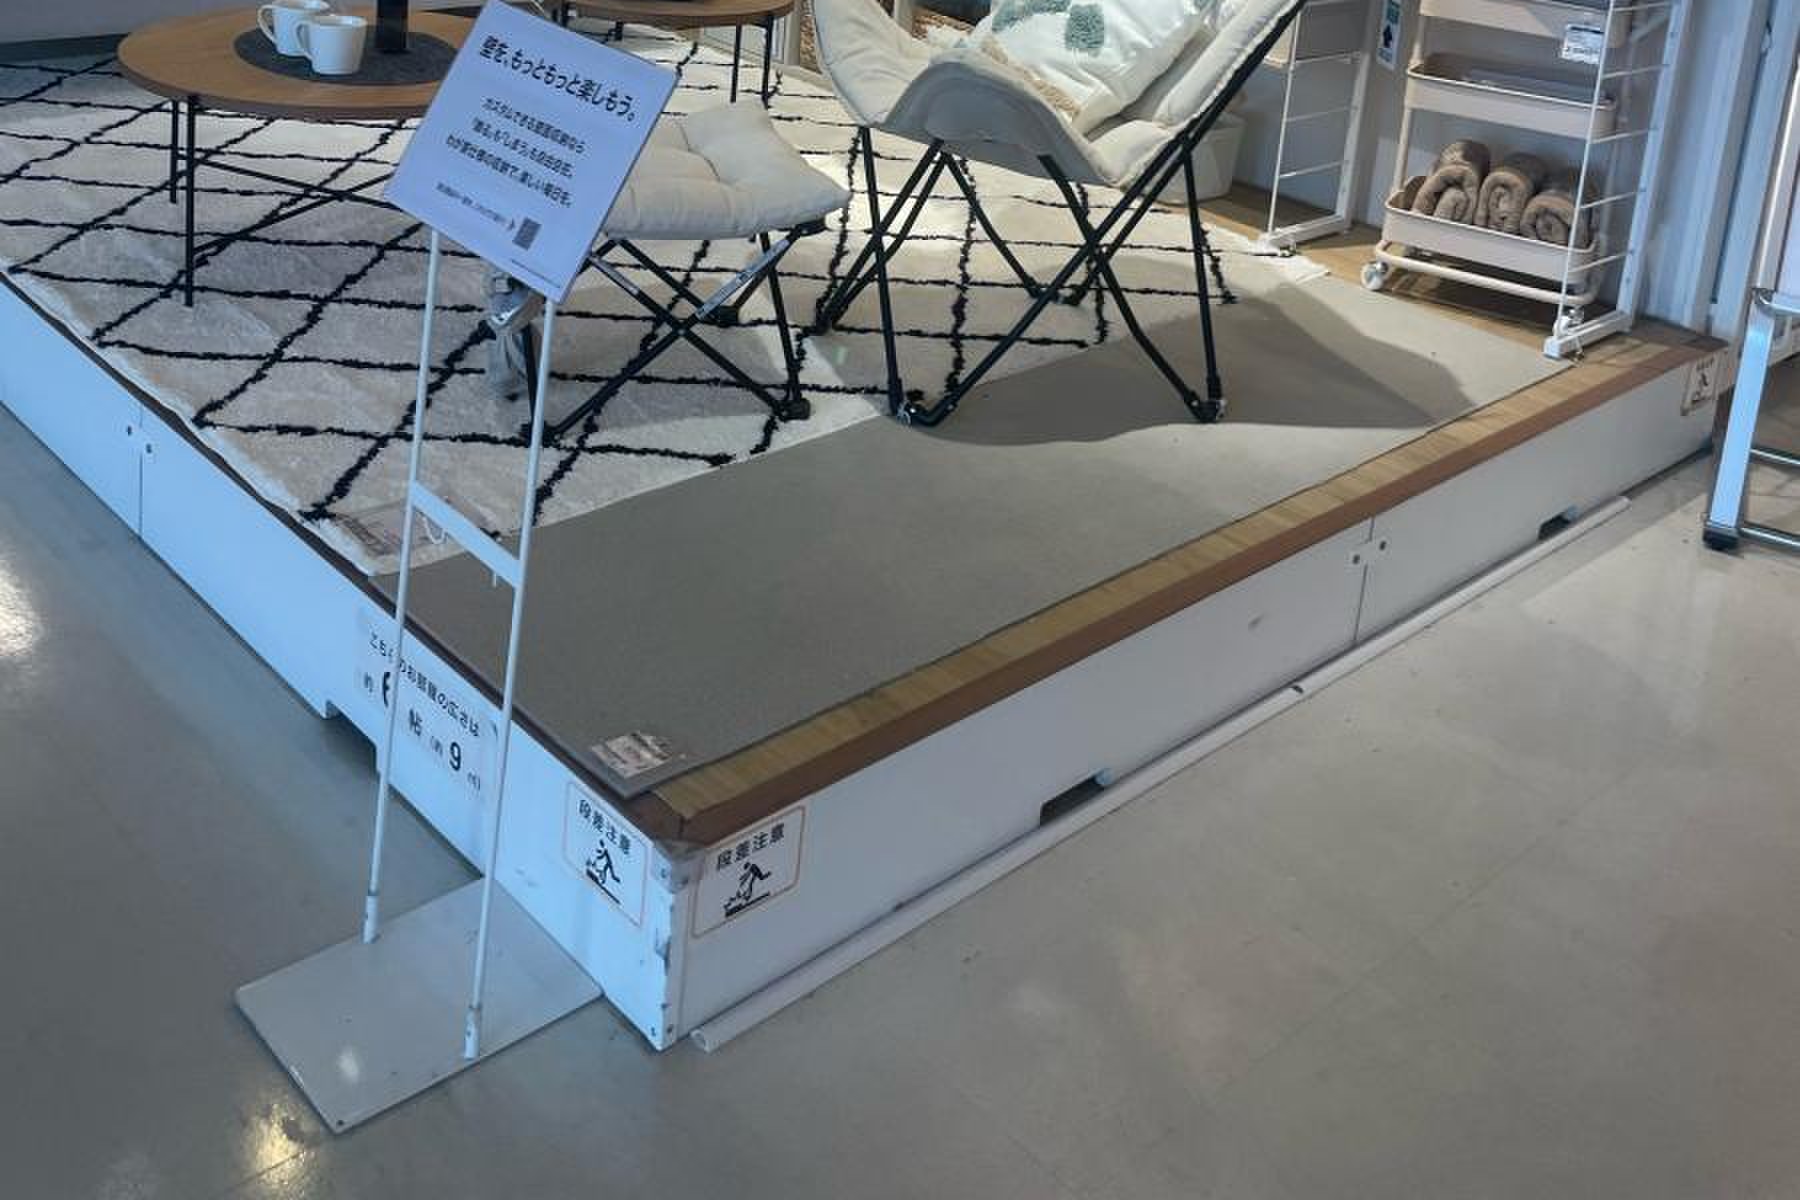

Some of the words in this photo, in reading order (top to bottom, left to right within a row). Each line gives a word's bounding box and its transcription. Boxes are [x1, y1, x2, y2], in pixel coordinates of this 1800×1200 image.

[479, 35, 635, 122] 壁を、もっともっと楽しもう。
[449, 741, 462, 772] 9
[578, 799, 632, 855] 段差注意
[716, 823, 784, 871] 段差注意
